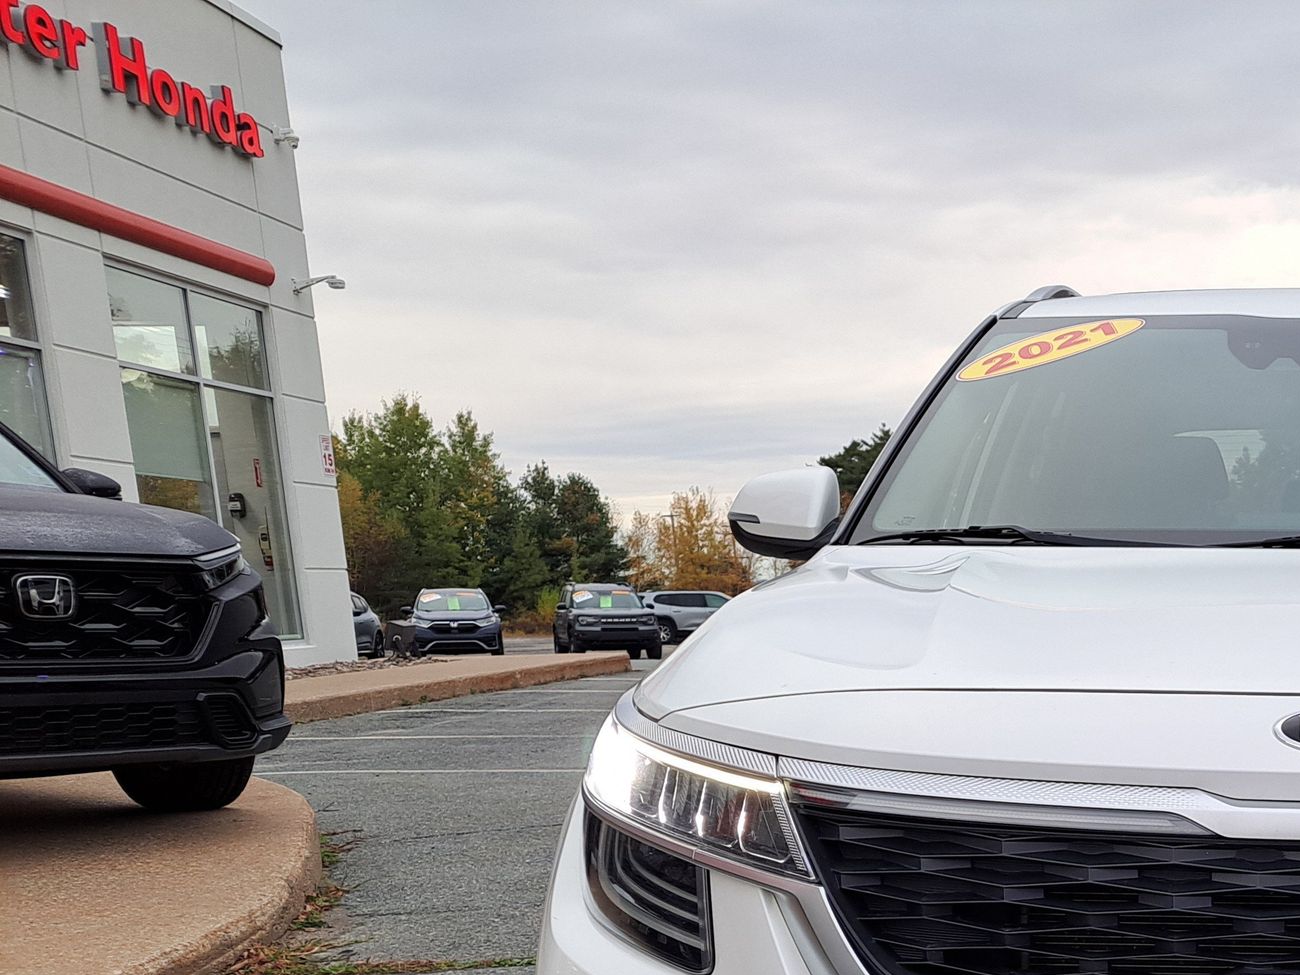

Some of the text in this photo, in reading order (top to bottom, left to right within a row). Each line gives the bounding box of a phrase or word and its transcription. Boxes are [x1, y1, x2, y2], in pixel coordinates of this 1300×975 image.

[104, 22, 264, 158] Honda
[982, 321, 1119, 376] 2021
[323, 452, 334, 468] 15
